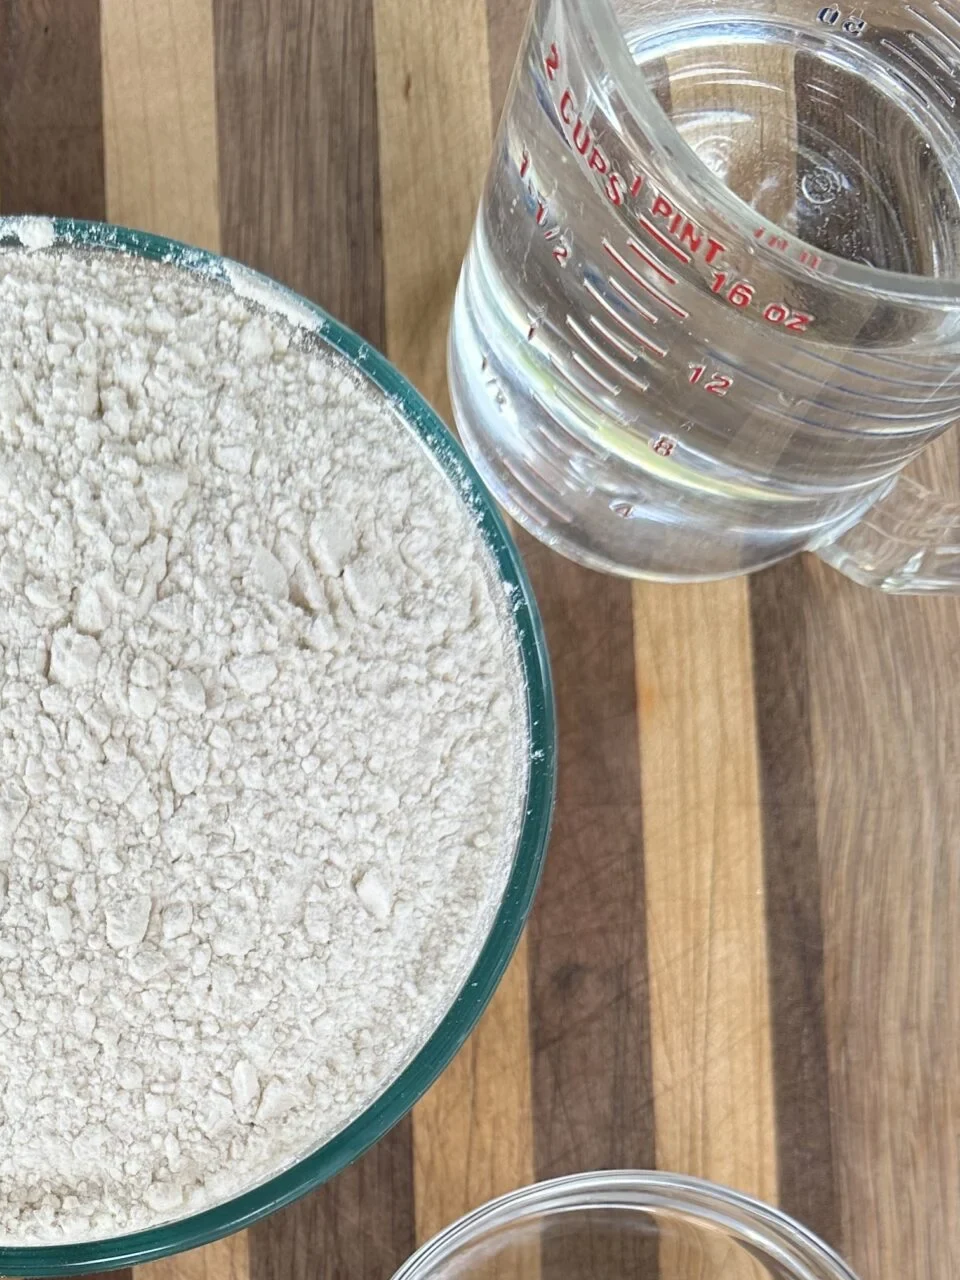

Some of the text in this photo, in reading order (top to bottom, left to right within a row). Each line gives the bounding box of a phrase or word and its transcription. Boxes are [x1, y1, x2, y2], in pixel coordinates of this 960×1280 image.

[560, 87, 625, 206] CUPS
[651, 195, 728, 264] PINT
[711, 270, 756, 309] 16
[762, 302, 815, 333] OZ
[689, 364, 734, 397] 12
